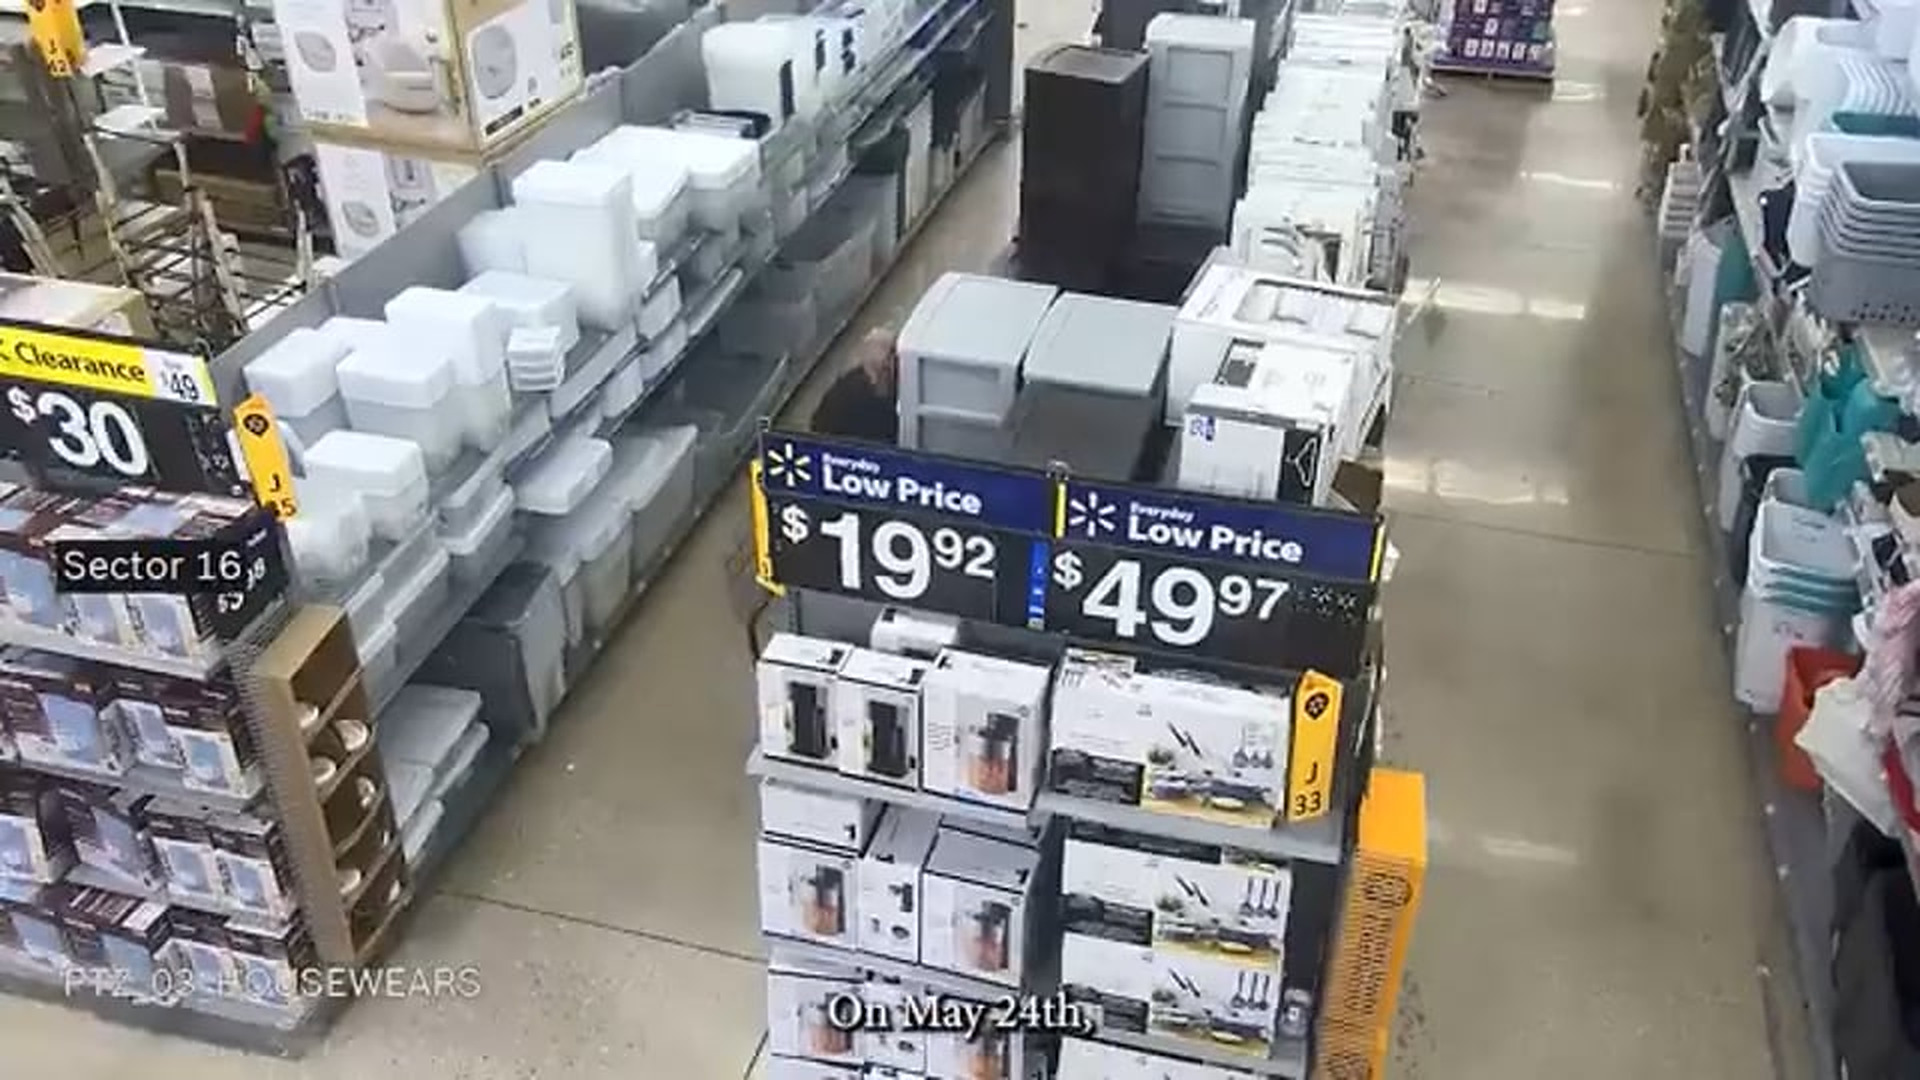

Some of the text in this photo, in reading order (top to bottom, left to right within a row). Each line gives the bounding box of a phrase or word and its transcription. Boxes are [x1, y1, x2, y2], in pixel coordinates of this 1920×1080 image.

[14, 341, 147, 382] Clearance
[822, 464, 983, 515] Low Price
[1127, 514, 1304, 562] Low Price
[1305, 761, 1318, 785] J
[1295, 791, 1321, 816] 33
